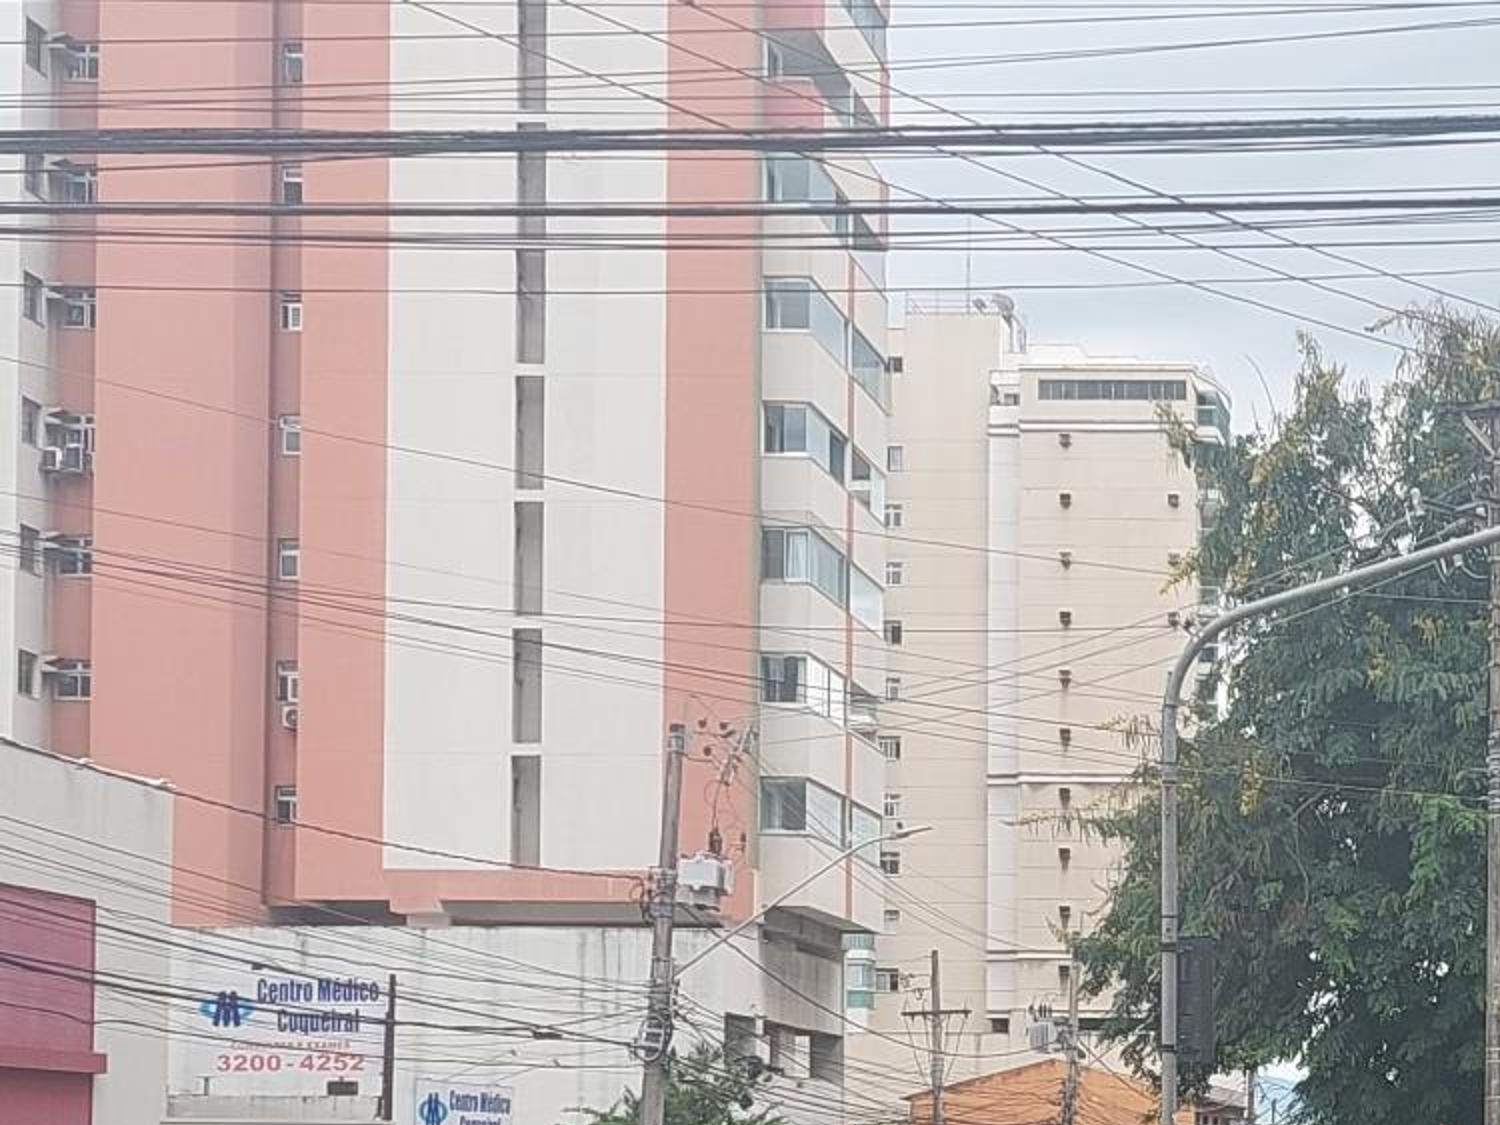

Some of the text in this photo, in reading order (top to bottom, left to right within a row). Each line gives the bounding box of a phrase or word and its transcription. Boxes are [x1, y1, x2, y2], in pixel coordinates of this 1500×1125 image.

[257, 978, 379, 1002] Centro Médico
[277, 1008, 360, 1035] Coqueiral
[449, 1089, 479, 1113] Centro
